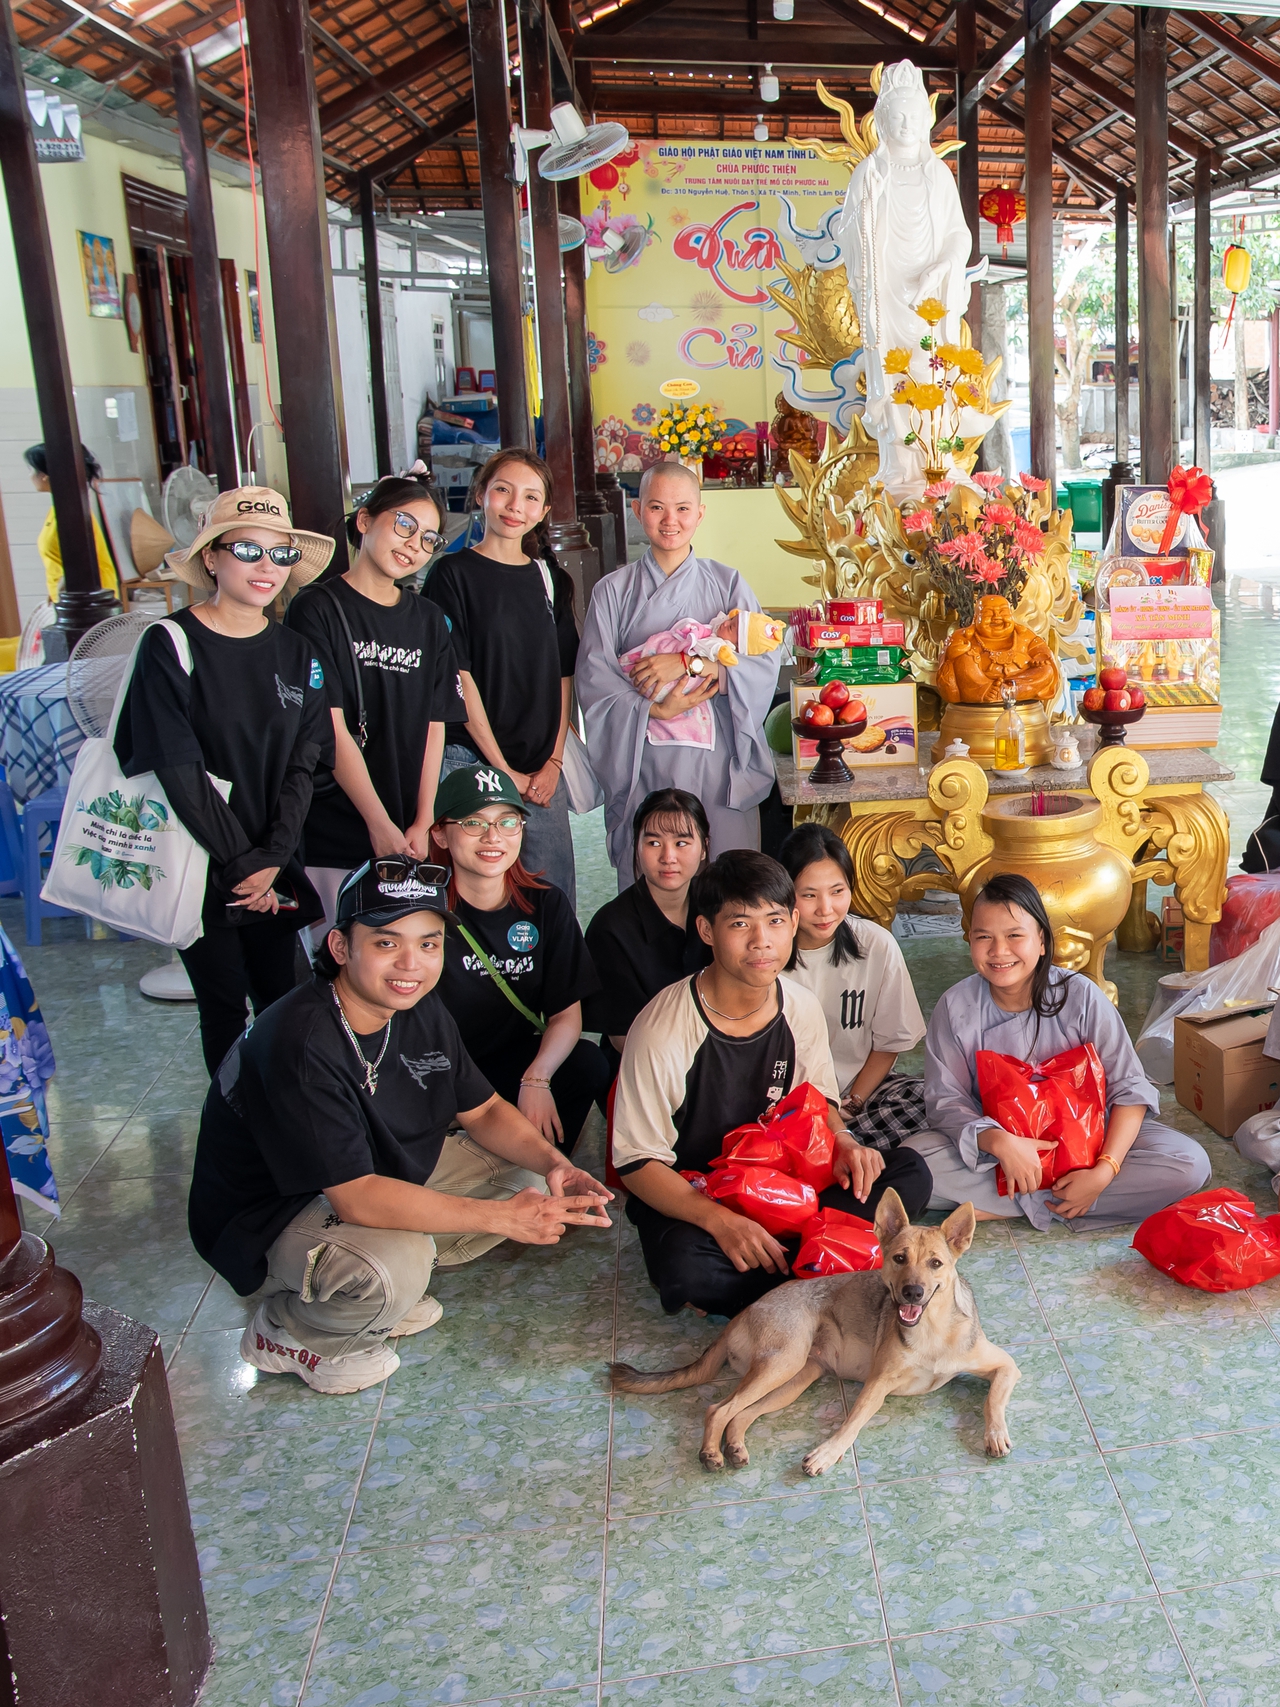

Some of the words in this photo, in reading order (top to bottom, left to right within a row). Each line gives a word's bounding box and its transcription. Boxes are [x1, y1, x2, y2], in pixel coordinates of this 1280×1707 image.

[658, 146, 679, 157] GIÁO
[681, 146, 696, 159] HỘI
[698, 146, 720, 159] PHẬT
[722, 147, 742, 158] GIÁO
[744, 147, 762, 160] VIỆT
[765, 149, 784, 159] NAM
[787, 147, 806, 159] TỈNH
[716, 162, 739, 173] CHÙA
[741, 162, 770, 174] PHƯỚC
[772, 163, 797, 176] THIỆN
[708, 177, 722, 185] TÂM
[741, 178, 754, 186] DẠY
[688, 187, 714, 196] Nguyễn
[236, 499, 281, 515] Gaia
[1134, 500, 1174, 518] Danisa
[1149, 613, 1165, 621] TÂN
[820, 630, 841, 639] COSY
[474, 769, 503, 792] NY
[82, 827, 97, 838] Việc
[134, 844, 156, 852] xanh!
[256, 1332, 322, 1373] BOSTON
